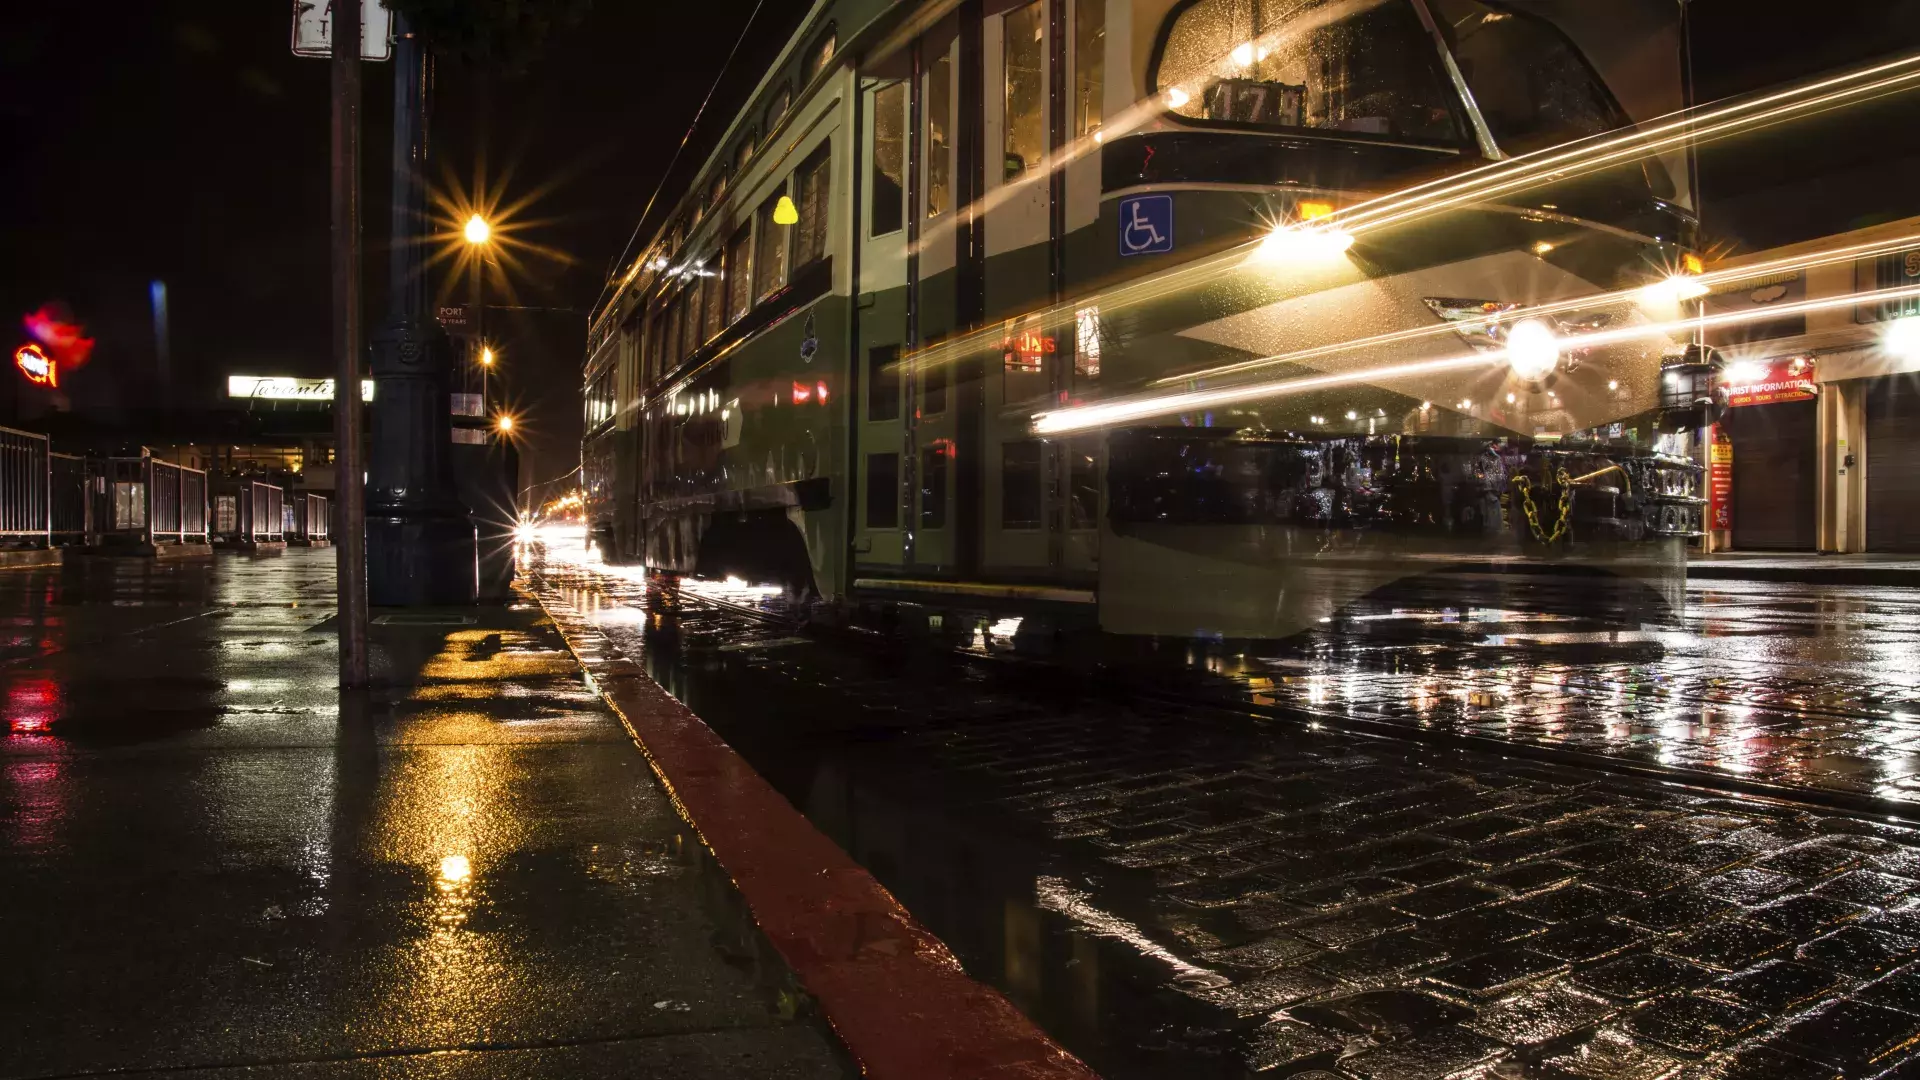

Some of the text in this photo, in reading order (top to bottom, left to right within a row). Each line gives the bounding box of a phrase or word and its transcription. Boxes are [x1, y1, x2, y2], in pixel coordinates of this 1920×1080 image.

[440, 307, 463, 316] PORT
[1751, 378, 1811, 393] INFORMATION
[1756, 394, 1772, 402] TOURS
